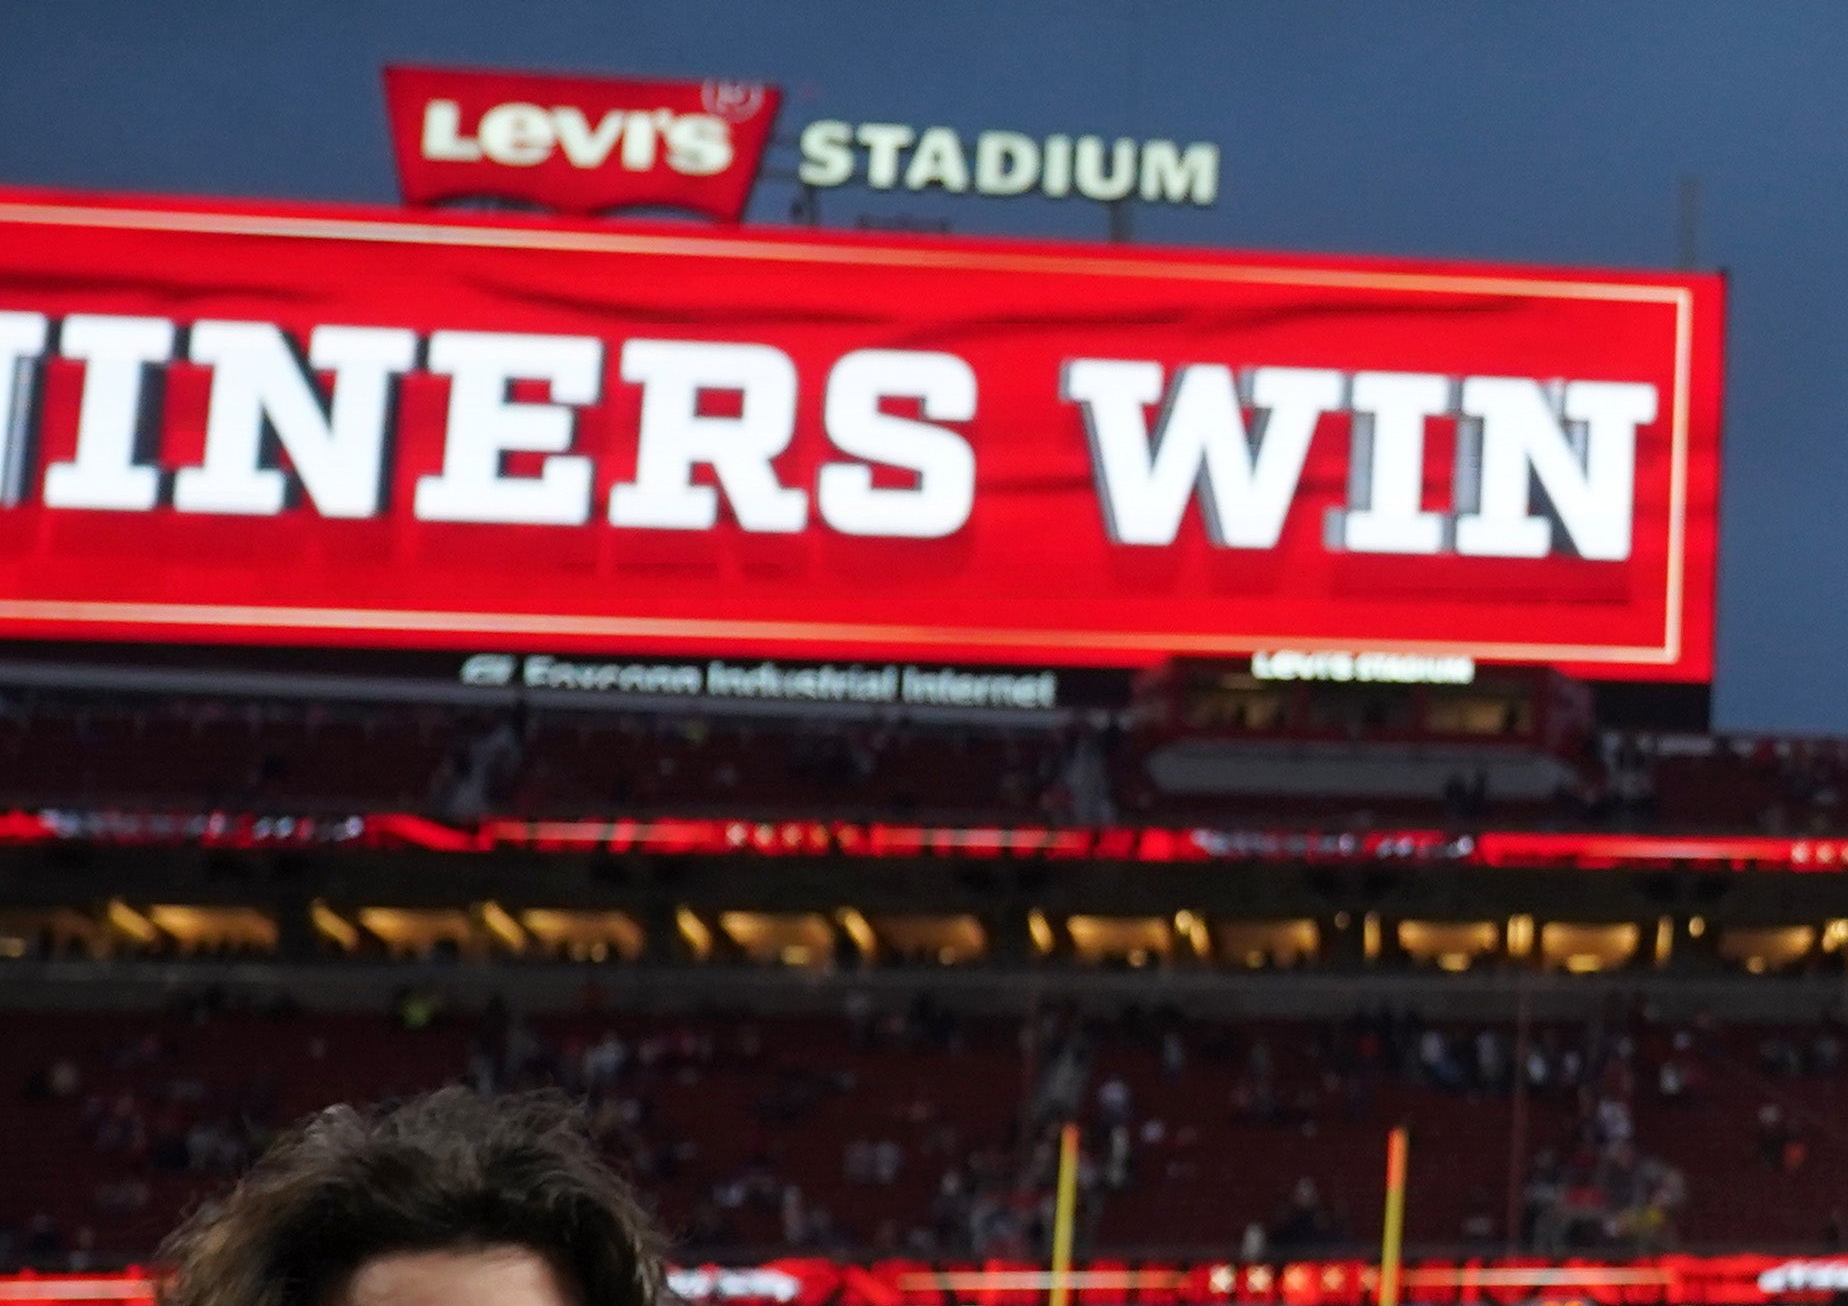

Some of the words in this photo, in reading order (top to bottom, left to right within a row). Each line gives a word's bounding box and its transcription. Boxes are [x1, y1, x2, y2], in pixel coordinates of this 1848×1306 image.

[799, 118, 1221, 205] STADIUM
[0, 311, 978, 539] INERS
[1061, 356, 1659, 562] WIN
